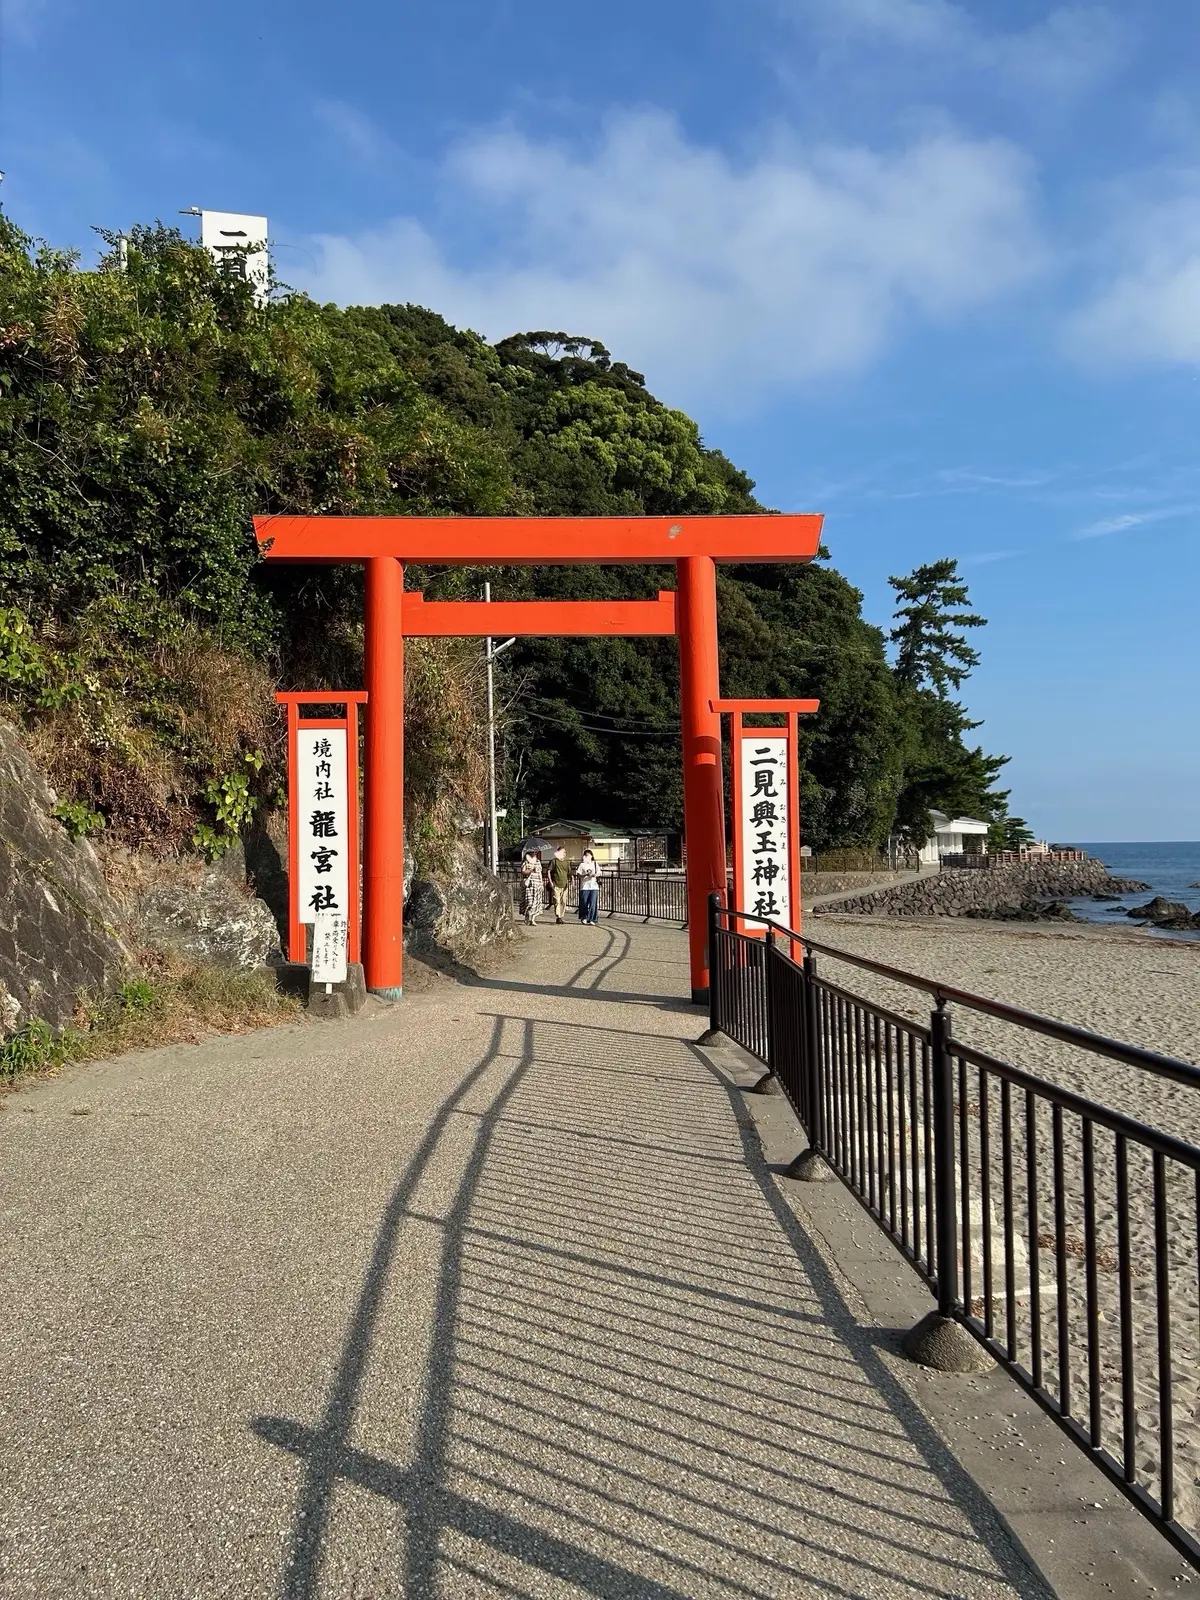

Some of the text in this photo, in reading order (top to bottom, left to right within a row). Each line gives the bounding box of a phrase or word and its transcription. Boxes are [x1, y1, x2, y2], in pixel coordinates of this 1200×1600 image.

[749, 747, 780, 917] 二見興玉神社
